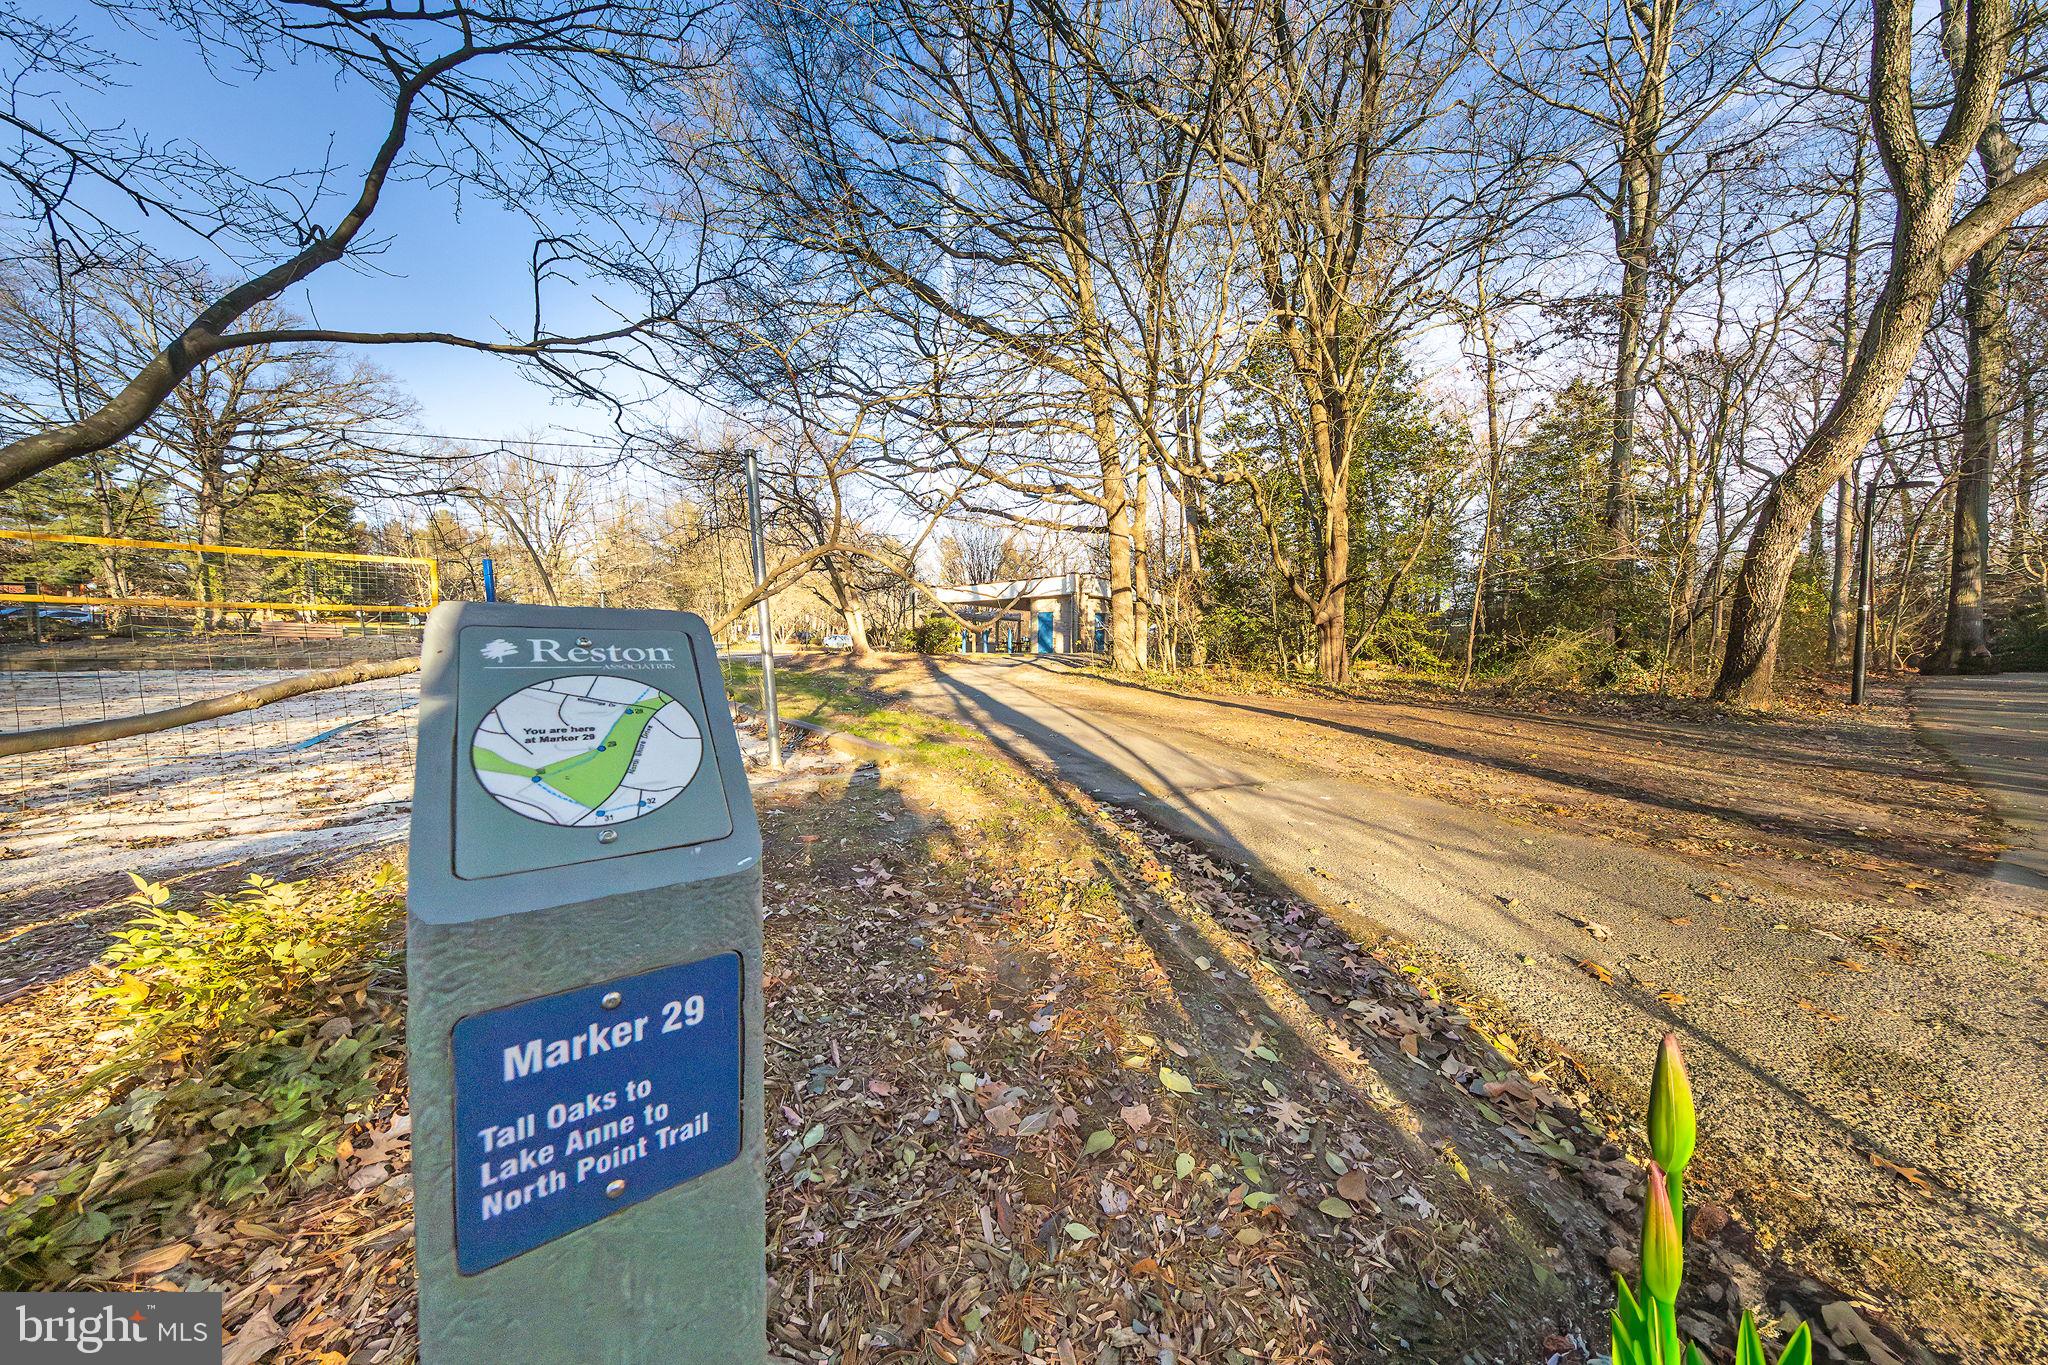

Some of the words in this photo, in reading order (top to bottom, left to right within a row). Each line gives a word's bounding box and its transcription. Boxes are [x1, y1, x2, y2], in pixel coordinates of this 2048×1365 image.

[527, 638, 674, 664] Reston
[602, 663, 676, 671] ASSOCIATION
[539, 735, 579, 743] Marker
[582, 733, 595, 741] 29
[503, 1014, 650, 1082] Marker
[661, 994, 705, 1035] 29
[478, 1113, 535, 1154] Tall
[546, 1089, 617, 1130] Oaks
[626, 1078, 652, 1103] to
[480, 1140, 554, 1188] Lake
[565, 1114, 635, 1156] Anne
[644, 1102, 669, 1127] to
[481, 1170, 566, 1221] North
[577, 1136, 648, 1184] Point
[655, 1111, 709, 1151] Trail
